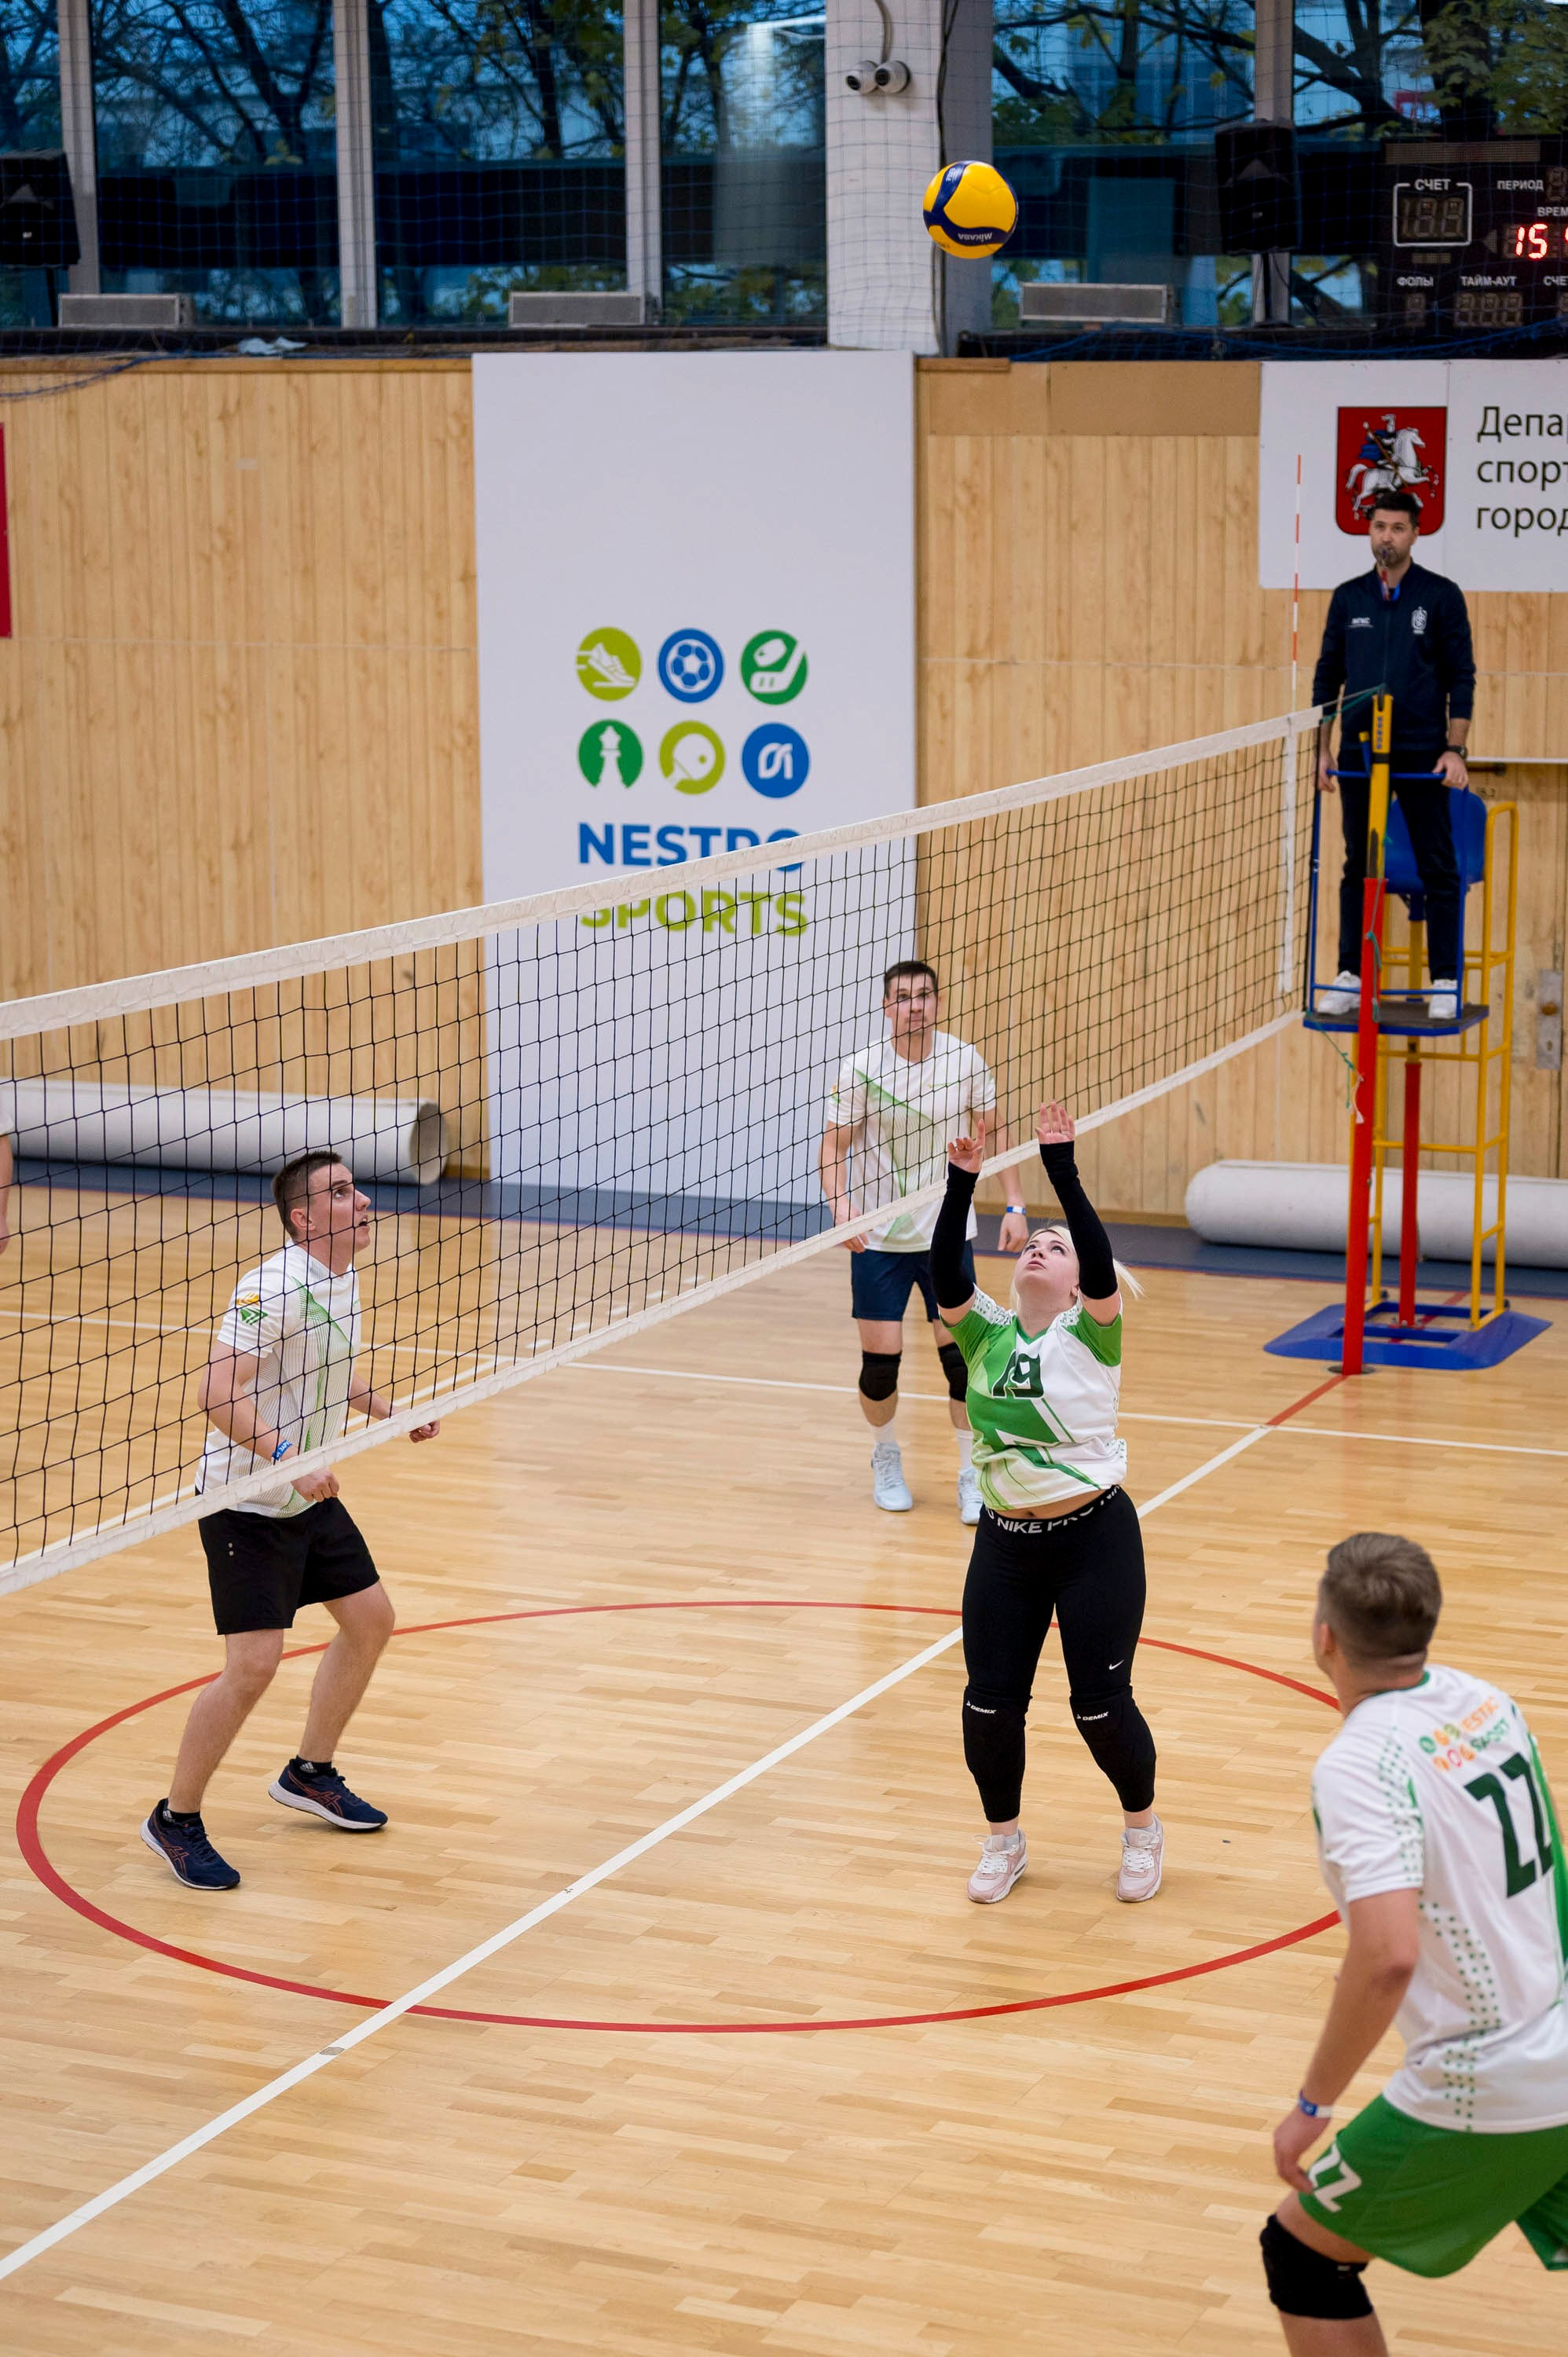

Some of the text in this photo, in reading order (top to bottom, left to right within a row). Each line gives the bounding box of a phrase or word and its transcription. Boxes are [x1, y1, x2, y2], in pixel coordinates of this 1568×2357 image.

[1415, 178, 1451, 191] СЧЕТ
[1497, 180, 1544, 191] ПЕРИОД
[1397, 276, 1434, 287] ФОЛЫ
[1460, 274, 1517, 287] ТАЙМ-АУТ
[1477, 405, 1568, 443] Депа
[997, 1516, 1043, 1534] NIKE
